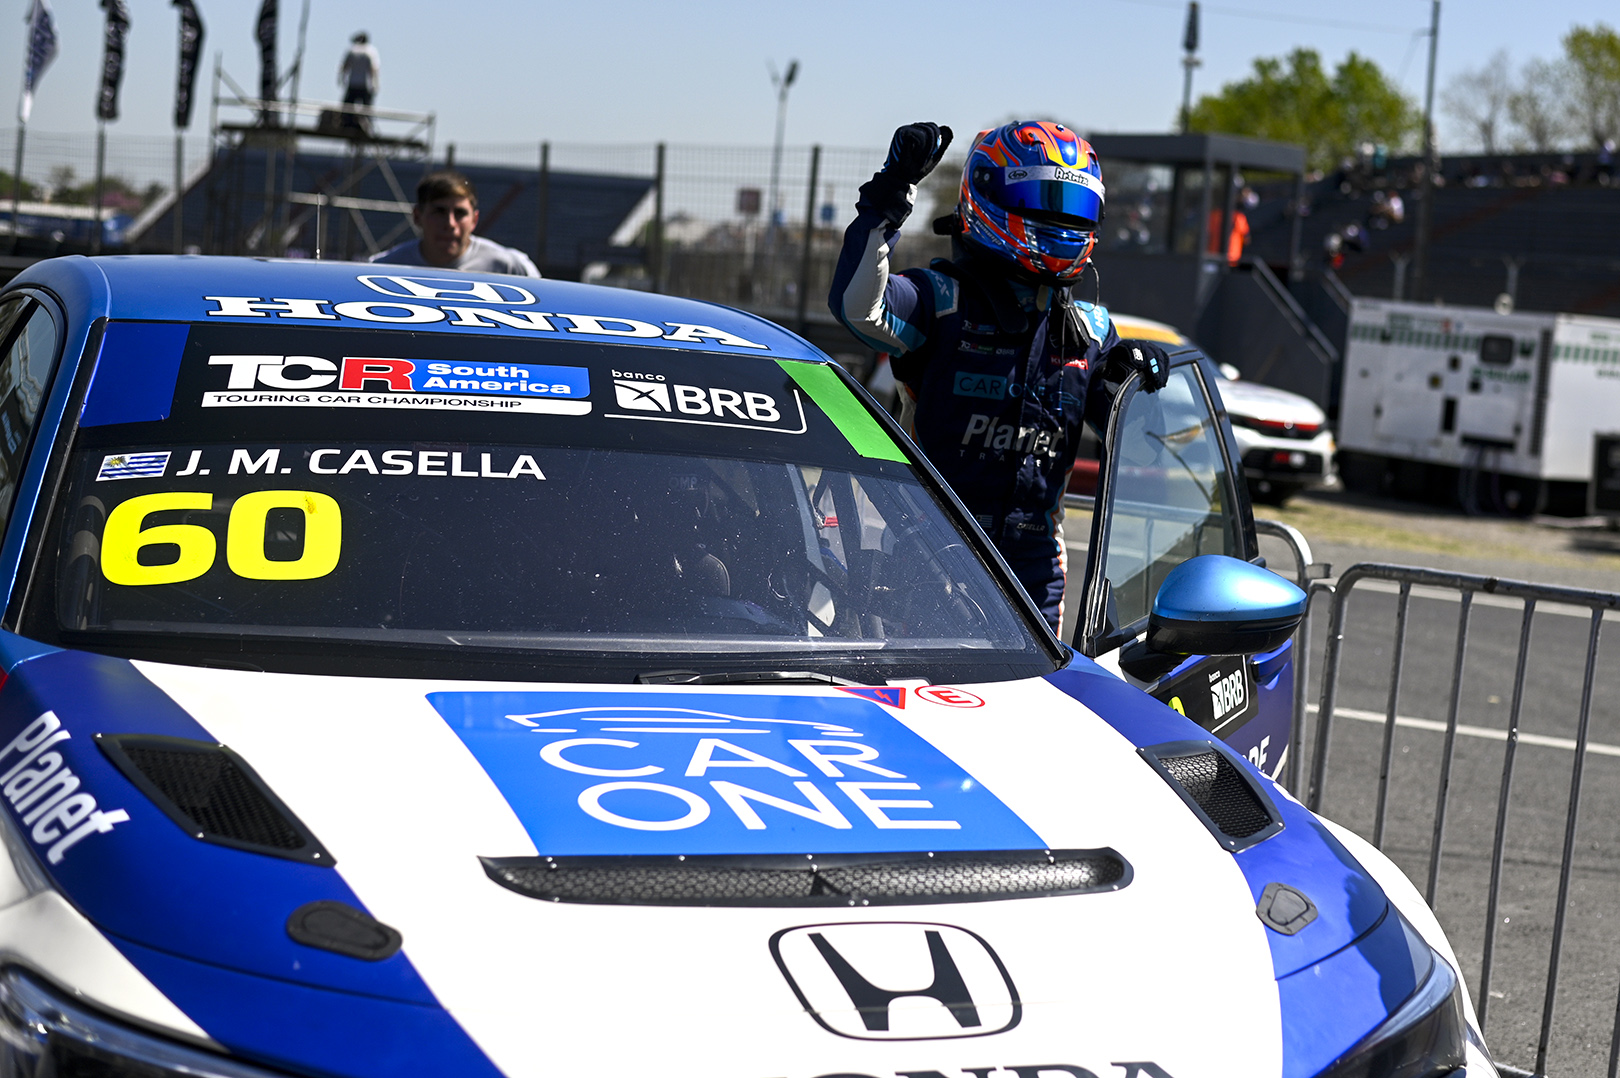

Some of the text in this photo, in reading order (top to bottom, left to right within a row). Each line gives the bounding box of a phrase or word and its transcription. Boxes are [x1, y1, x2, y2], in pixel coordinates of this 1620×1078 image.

[204, 296, 769, 350] HONDA
[208, 355, 416, 392] TCR
[423, 376, 572, 395] America
[427, 363, 530, 379] South
[611, 369, 666, 381] banco
[959, 376, 1001, 396] CAR
[213, 395, 522, 408] TOURING CAR CHAMPIONSHIP
[673, 384, 781, 422] BRB
[961, 413, 1065, 458] Planet
[176, 448, 547, 481] J. M. CASELLA
[100, 490, 342, 586] 60
[1222, 669, 1244, 713] BRB
[539, 737, 907, 778] CAR
[0, 710, 131, 865] Planet
[577, 781, 962, 831] ONE
